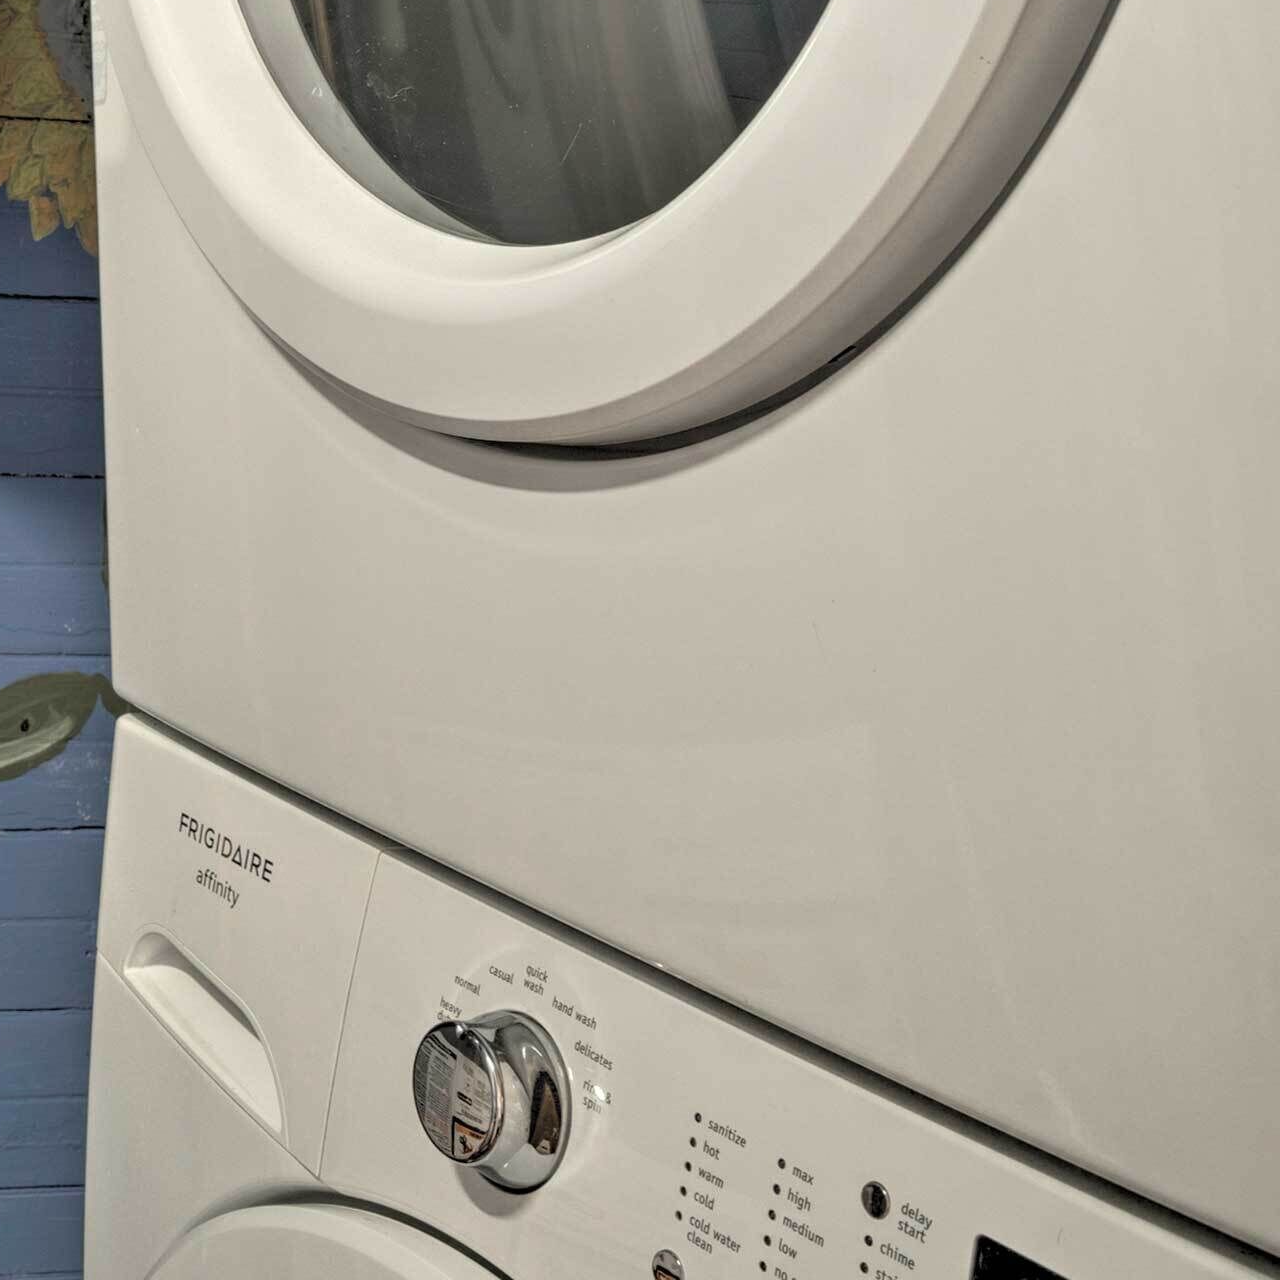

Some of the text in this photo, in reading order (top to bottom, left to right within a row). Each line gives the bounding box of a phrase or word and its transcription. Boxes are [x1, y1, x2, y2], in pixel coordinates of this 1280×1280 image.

[178, 812, 274, 883] FRIGIDAIRE
[195, 868, 240, 909] affinity
[454, 974, 481, 996] normal
[489, 964, 514, 985] casual
[526, 964, 549, 983] quick
[523, 978, 544, 996] wash
[440, 996, 462, 1019] heavy
[552, 996, 597, 1031] hand wash
[574, 1039, 613, 1072] delicates
[582, 1095, 602, 1114] spin
[707, 1118, 748, 1148] sanitize
[702, 1140, 721, 1161] hot
[698, 1166, 725, 1190] warm
[792, 1163, 816, 1186] max
[693, 1188, 716, 1211] cold
[787, 1186, 812, 1213] high
[900, 1202, 933, 1230] delay
[686, 1229, 713, 1255] clean
[689, 1213, 742, 1254] cold water
[782, 1214, 826, 1248] medium
[897, 1218, 928, 1245] start
[778, 1237, 798, 1260] low
[879, 1240, 916, 1271] chime
